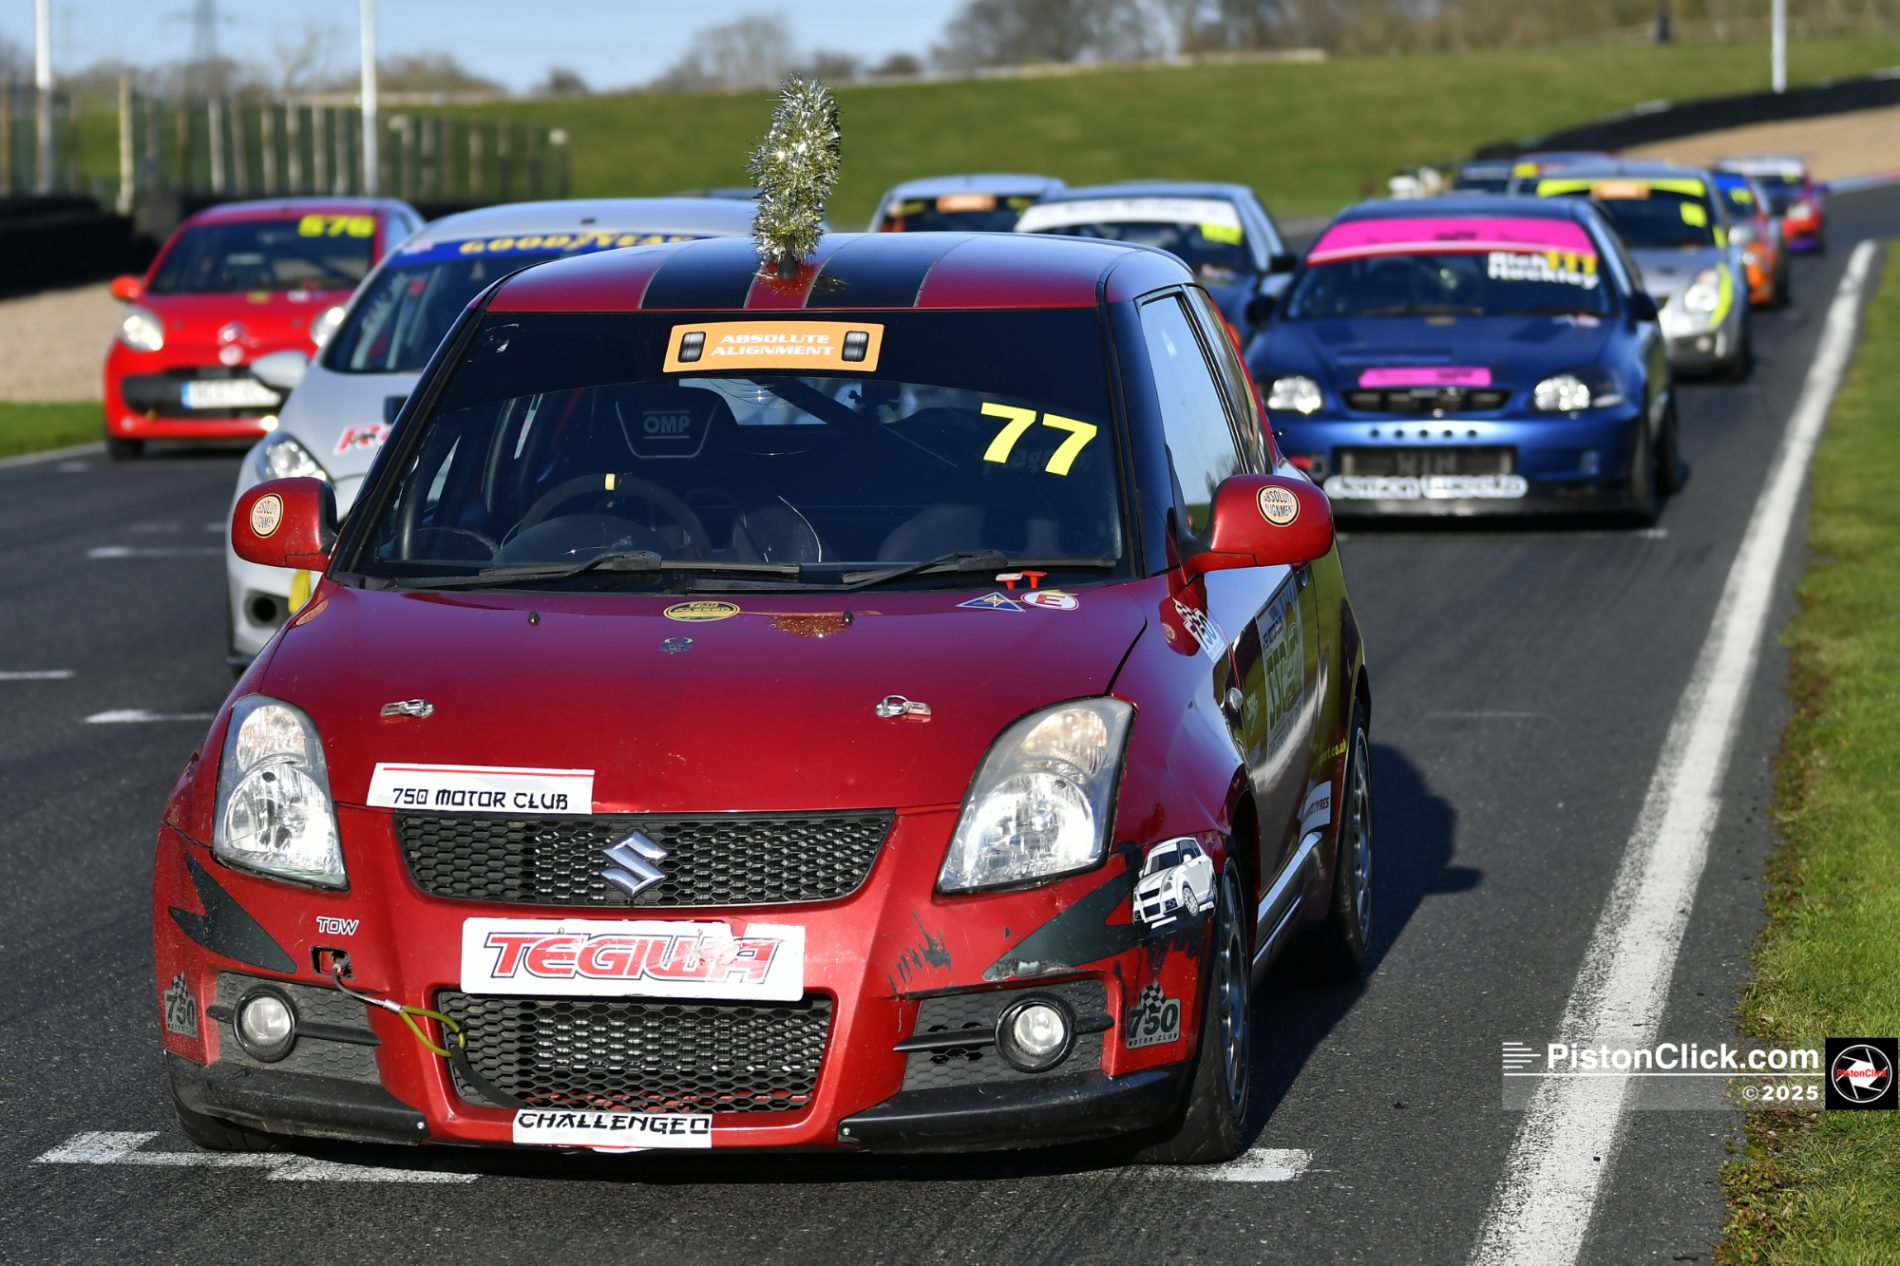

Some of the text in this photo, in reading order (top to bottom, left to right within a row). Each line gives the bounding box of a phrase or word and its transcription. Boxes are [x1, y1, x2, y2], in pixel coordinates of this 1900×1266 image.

[720, 334, 831, 344] ABSOLUTE
[710, 345, 835, 356] ALIGNMENT
[643, 418, 690, 433] OMP
[980, 402, 1098, 476] 77
[393, 788, 568, 810] 750 MOTOR CLUB
[316, 916, 360, 936] TOW
[484, 932, 785, 984] TEGIWA
[166, 994, 196, 1026] 750
[1130, 1003, 1179, 1038] 750
